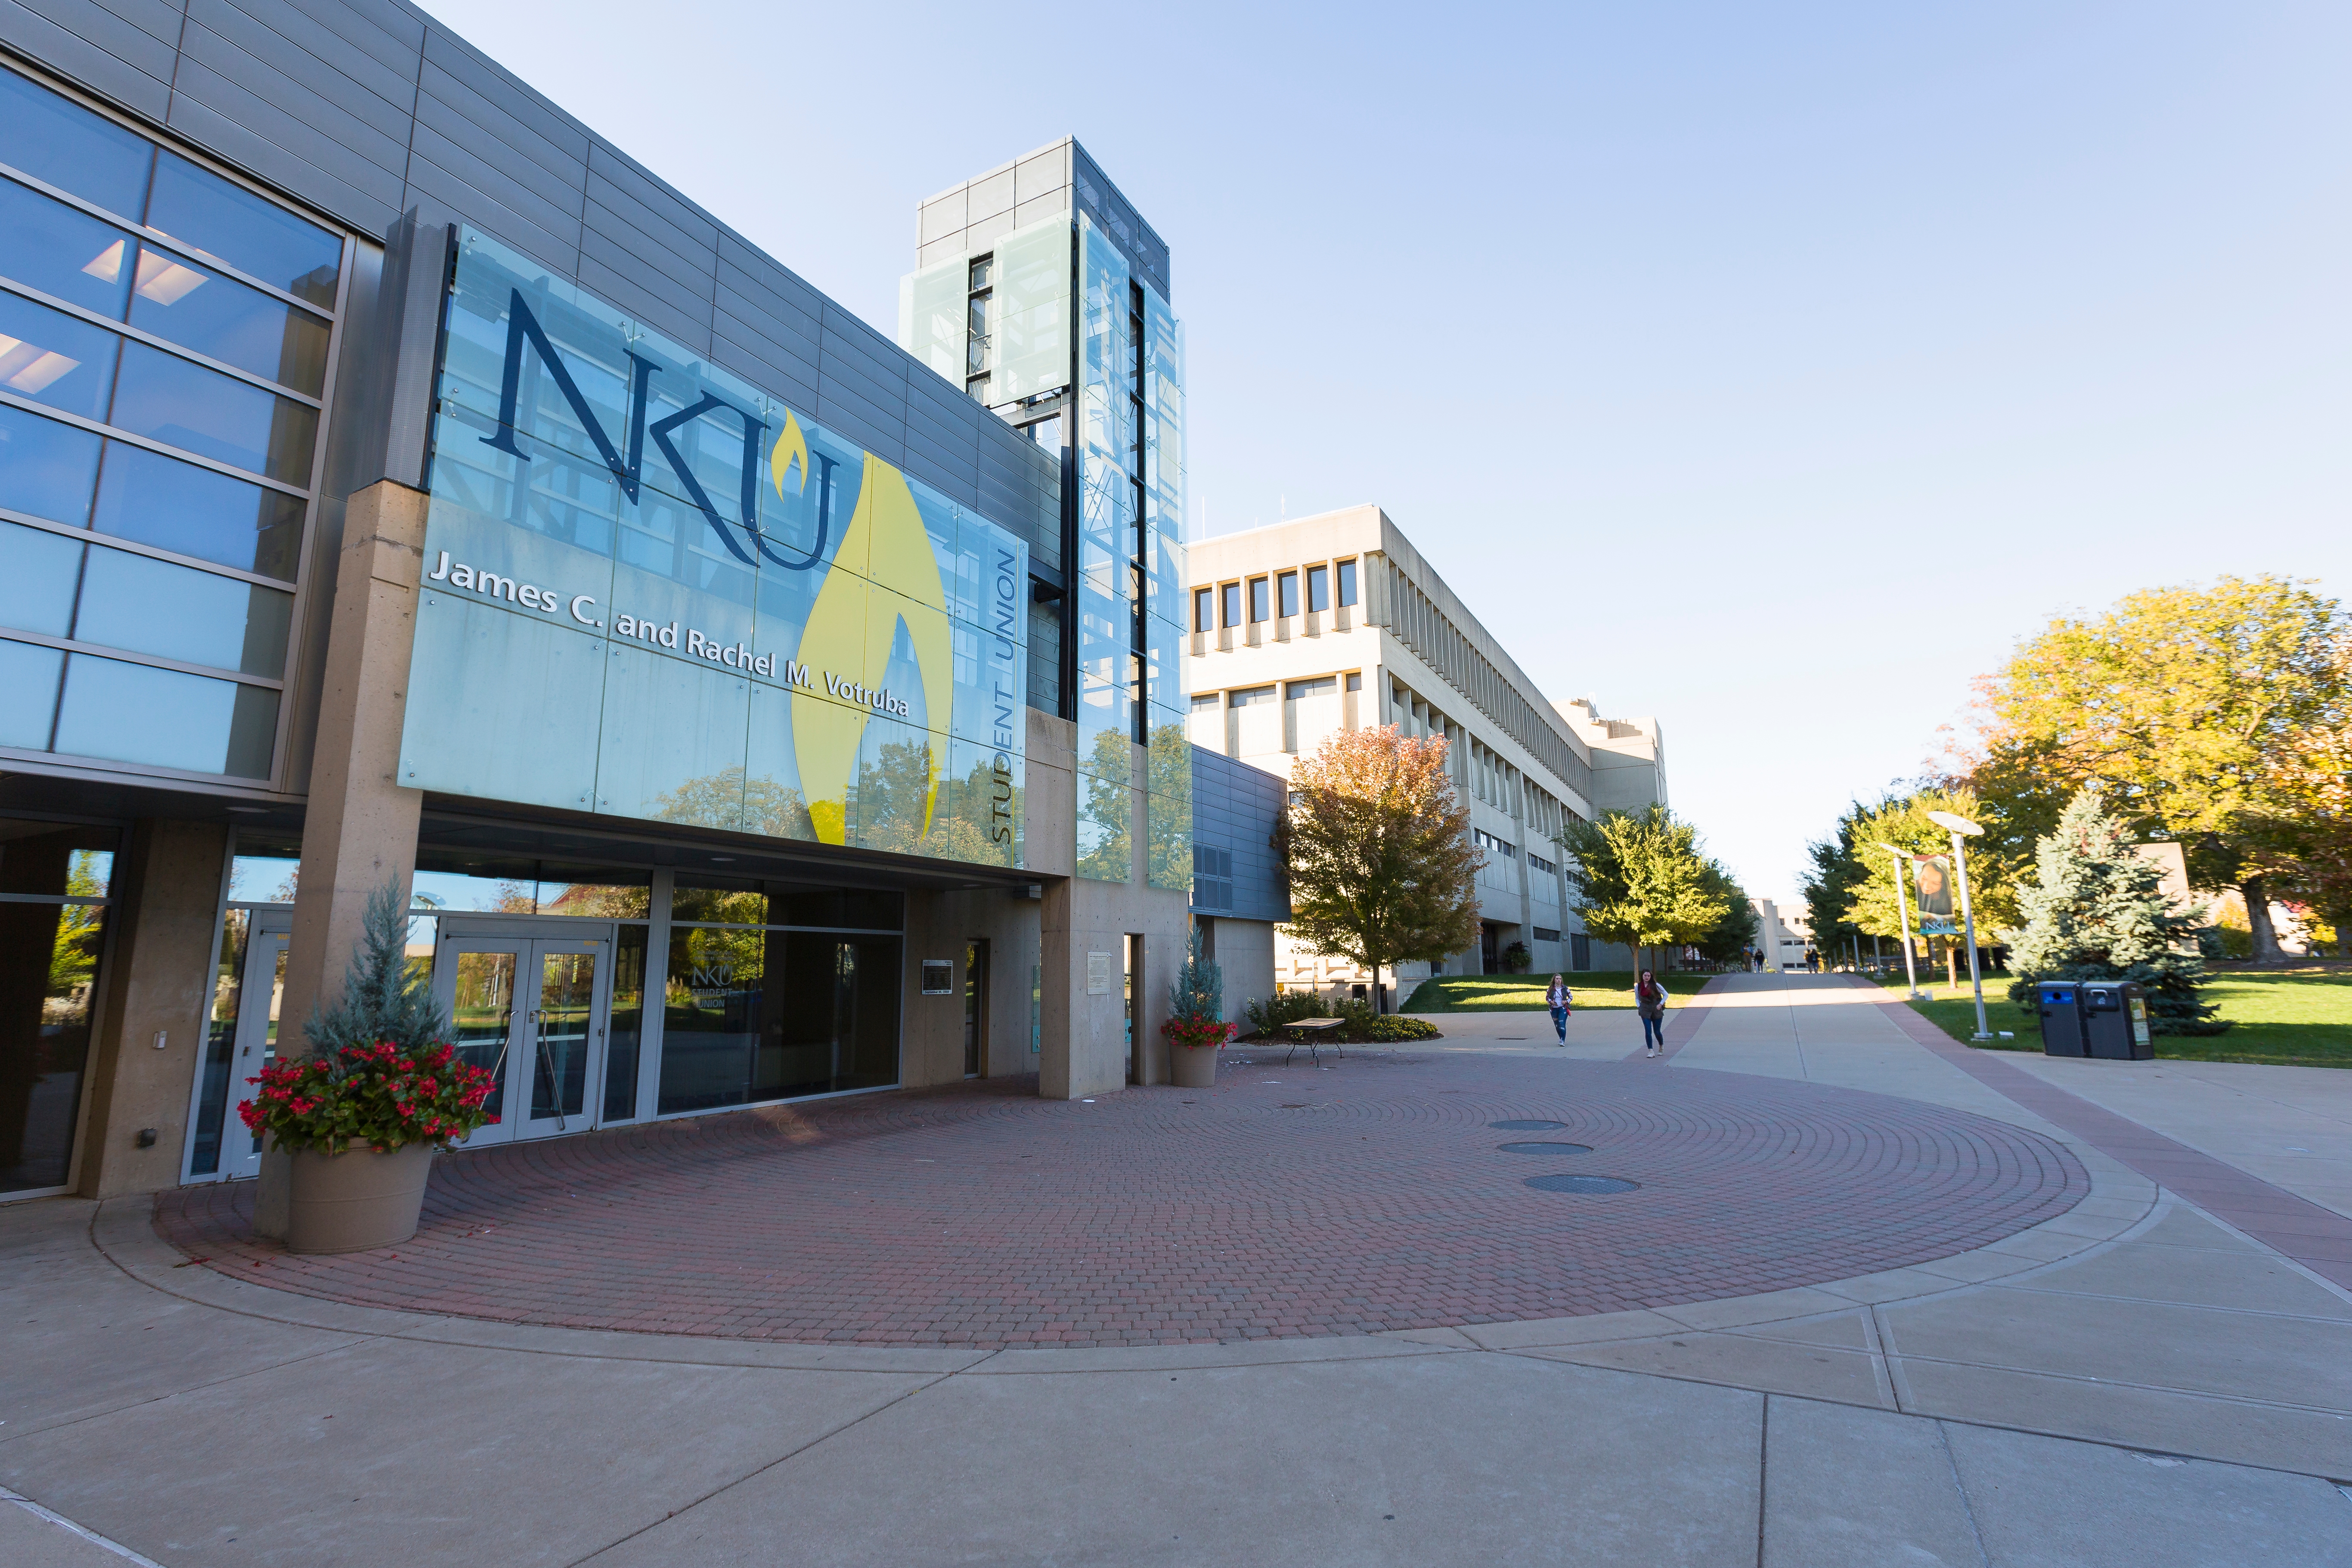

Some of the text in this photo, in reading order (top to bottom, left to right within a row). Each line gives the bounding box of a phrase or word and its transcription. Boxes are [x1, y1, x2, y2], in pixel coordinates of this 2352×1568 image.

[479, 287, 840, 571] NKU
[429, 551, 909, 717] James C. and Rachel M. Votruba
[992, 548, 1015, 845] STUDENT UNION
[1925, 921, 1950, 930] NKU
[692, 963, 733, 987] NKU
[691, 988, 732, 997] STUDENT
[697, 999, 725, 1008] UNION
